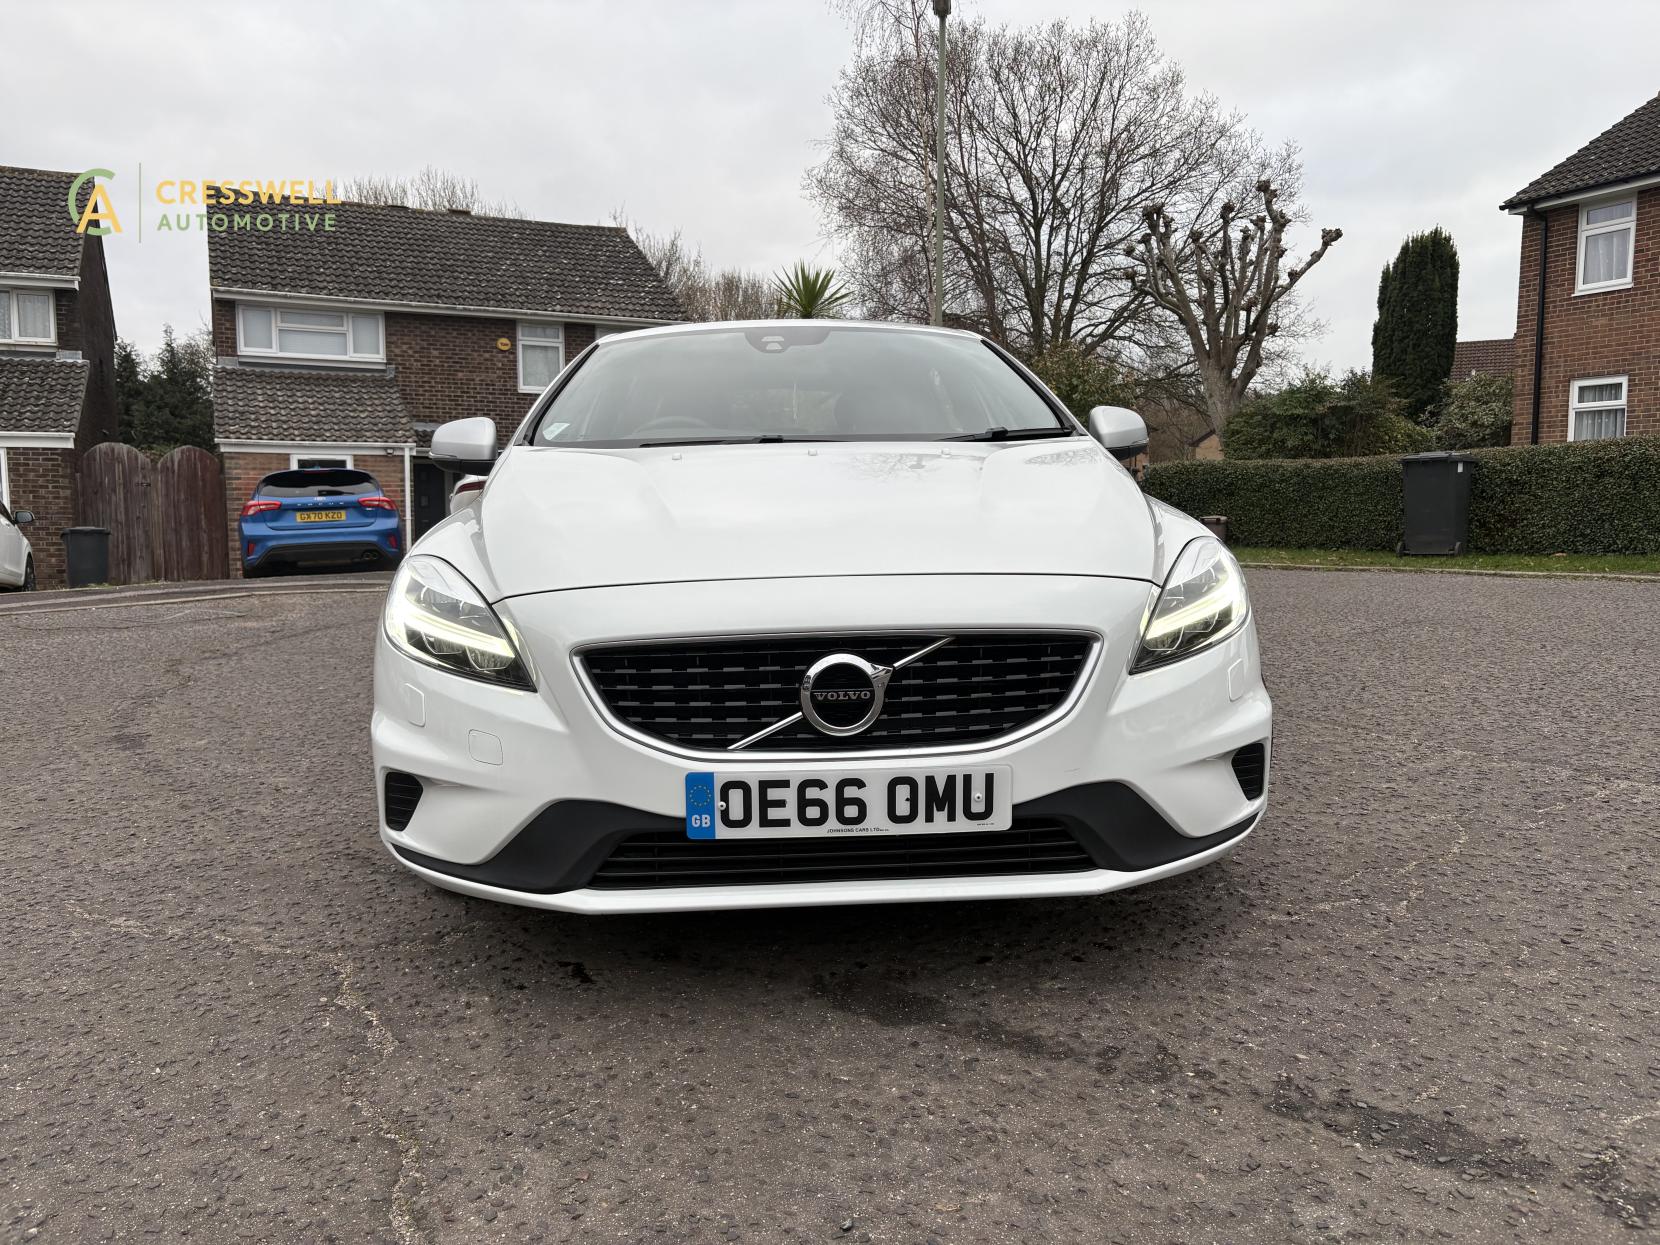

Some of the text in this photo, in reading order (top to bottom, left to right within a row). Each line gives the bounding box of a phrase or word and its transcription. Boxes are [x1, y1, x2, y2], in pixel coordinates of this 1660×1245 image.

[300, 512, 323, 520] GX70
[814, 691, 871, 700] VOLVO
[720, 773, 994, 828] OE66 OMU
[691, 814, 711, 828] GB
